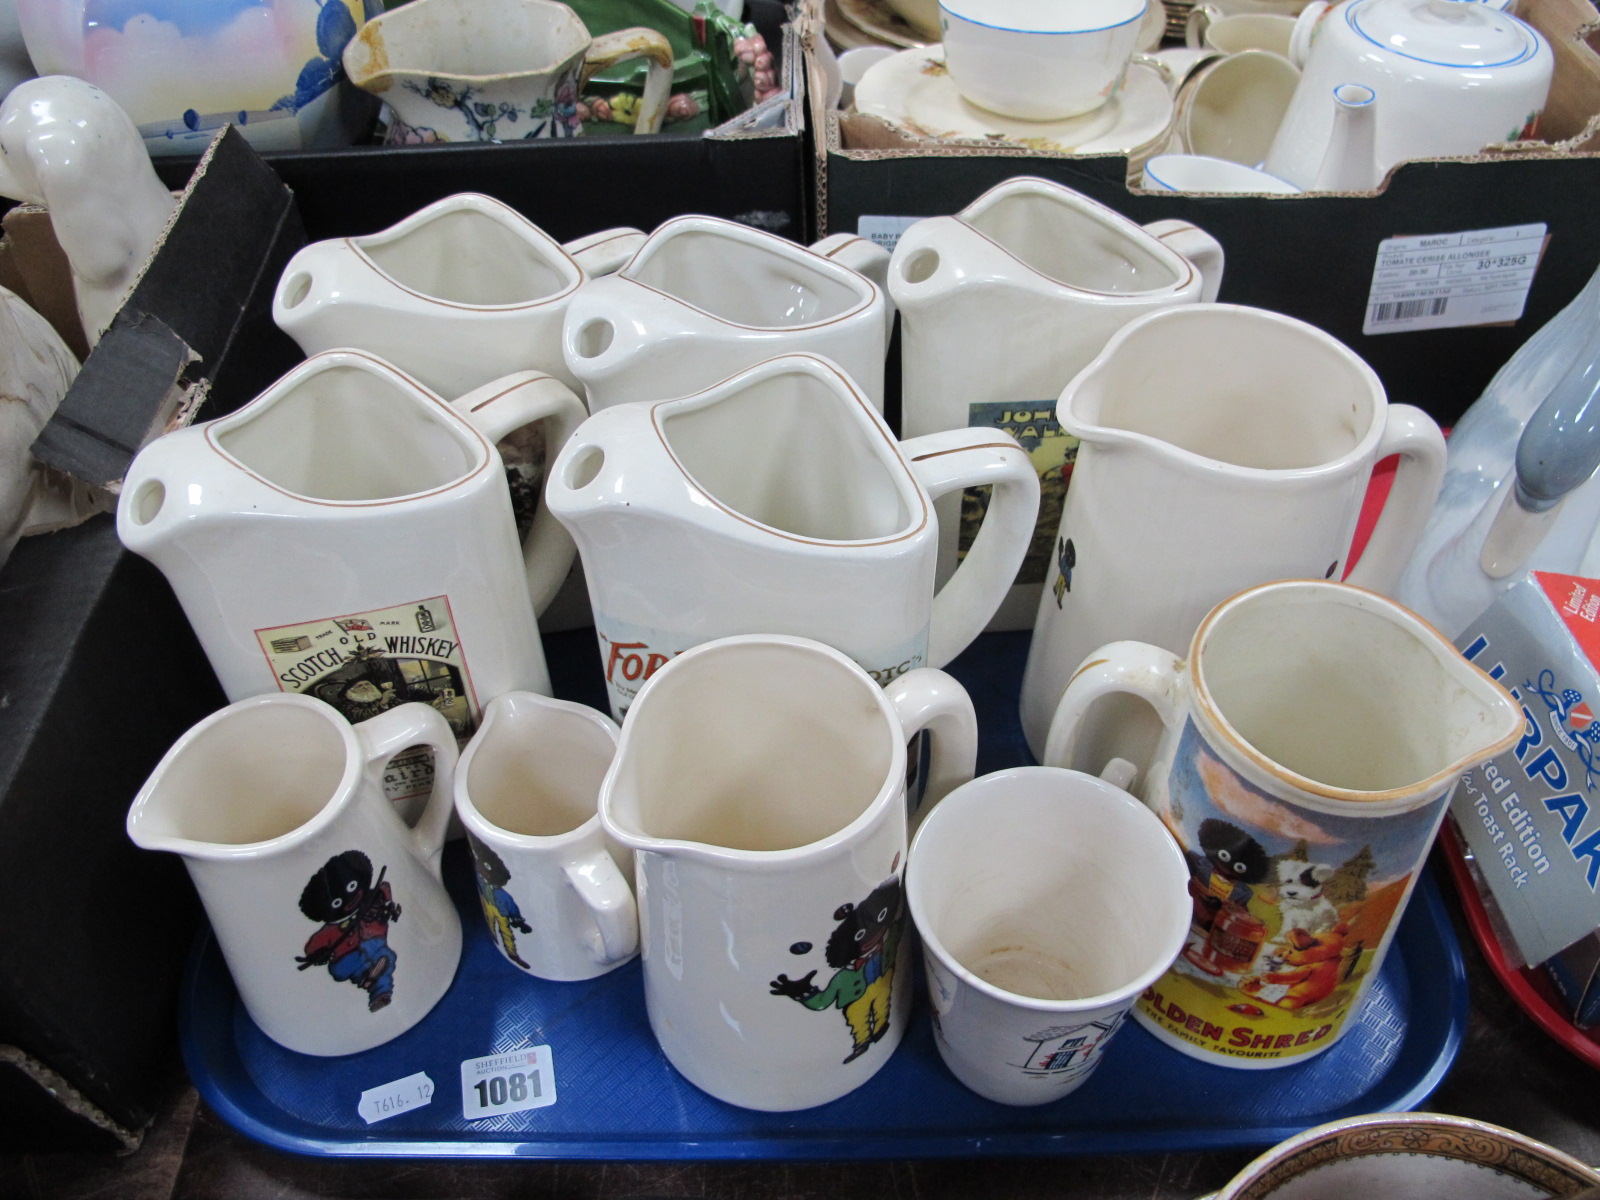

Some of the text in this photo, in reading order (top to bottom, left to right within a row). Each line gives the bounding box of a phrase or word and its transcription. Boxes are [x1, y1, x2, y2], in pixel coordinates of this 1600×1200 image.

[1419, 238, 1449, 247] MAROC
[1381, 256, 1415, 267] TOMATE
[1417, 253, 1446, 264] CERISE
[995, 408, 1058, 425] JOH
[1562, 581, 1587, 615] Limited
[315, 630, 334, 640] TRADE
[339, 632, 377, 645] OLD
[280, 635, 459, 688] SCOTCH WHISKEY
[1551, 714, 1576, 749] SINCE 1901
[1462, 633, 1600, 894] RPAK
[1480, 758, 1551, 875] ted Edition
[1473, 792, 1505, 844] Toast
[1498, 842, 1530, 889] Rack
[1141, 986, 1333, 1050] OLDEN SHRED
[1145, 1006, 1282, 1058] THE FAMILY FAVOURITE
[475, 1053, 527, 1070] SHEFFIELD
[476, 1065, 508, 1075] AUCTION
[373, 1084, 431, 1114] T616. 12
[474, 1069, 543, 1108] 1081
